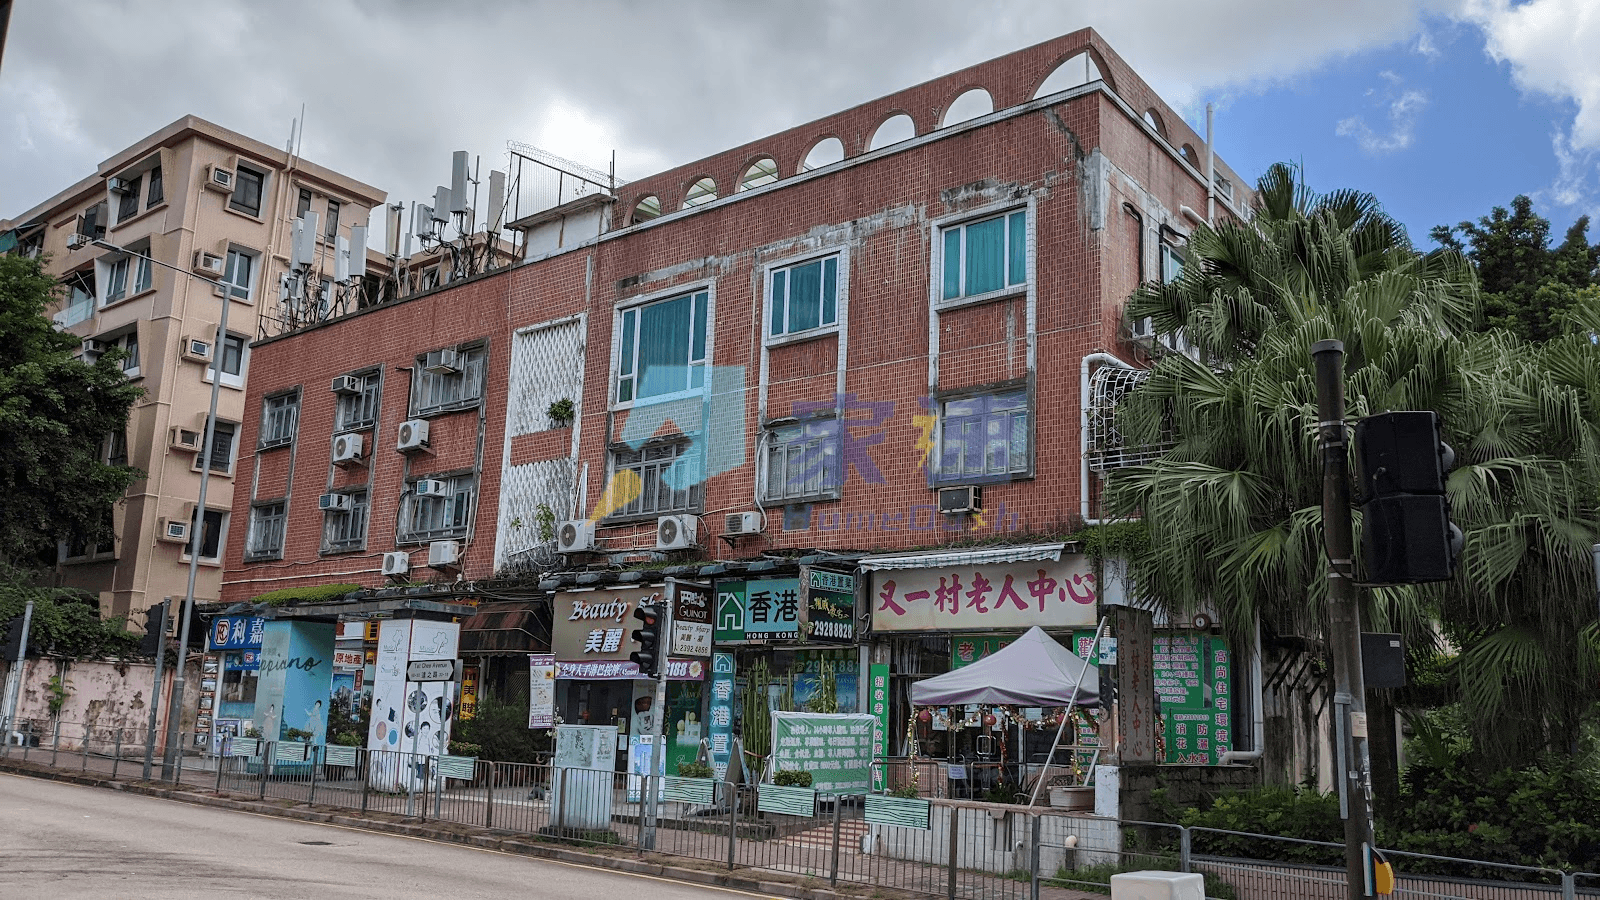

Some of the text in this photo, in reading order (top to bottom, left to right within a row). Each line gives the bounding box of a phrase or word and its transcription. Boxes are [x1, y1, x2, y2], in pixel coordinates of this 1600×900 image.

[748, 588, 798, 624] 香港
[877, 570, 1097, 617] 又一村老人中心
[568, 597, 627, 623] Beauty
[230, 617, 264, 645] 利嘉
[583, 626, 624, 654] 美麗
[746, 631, 799, 640] HONG KONG
[814, 620, 852, 639] 29288828
[334, 652, 362, 665] 原地產
[461, 685, 475, 713] 美聯
[1175, 722, 1209, 736] 消防
